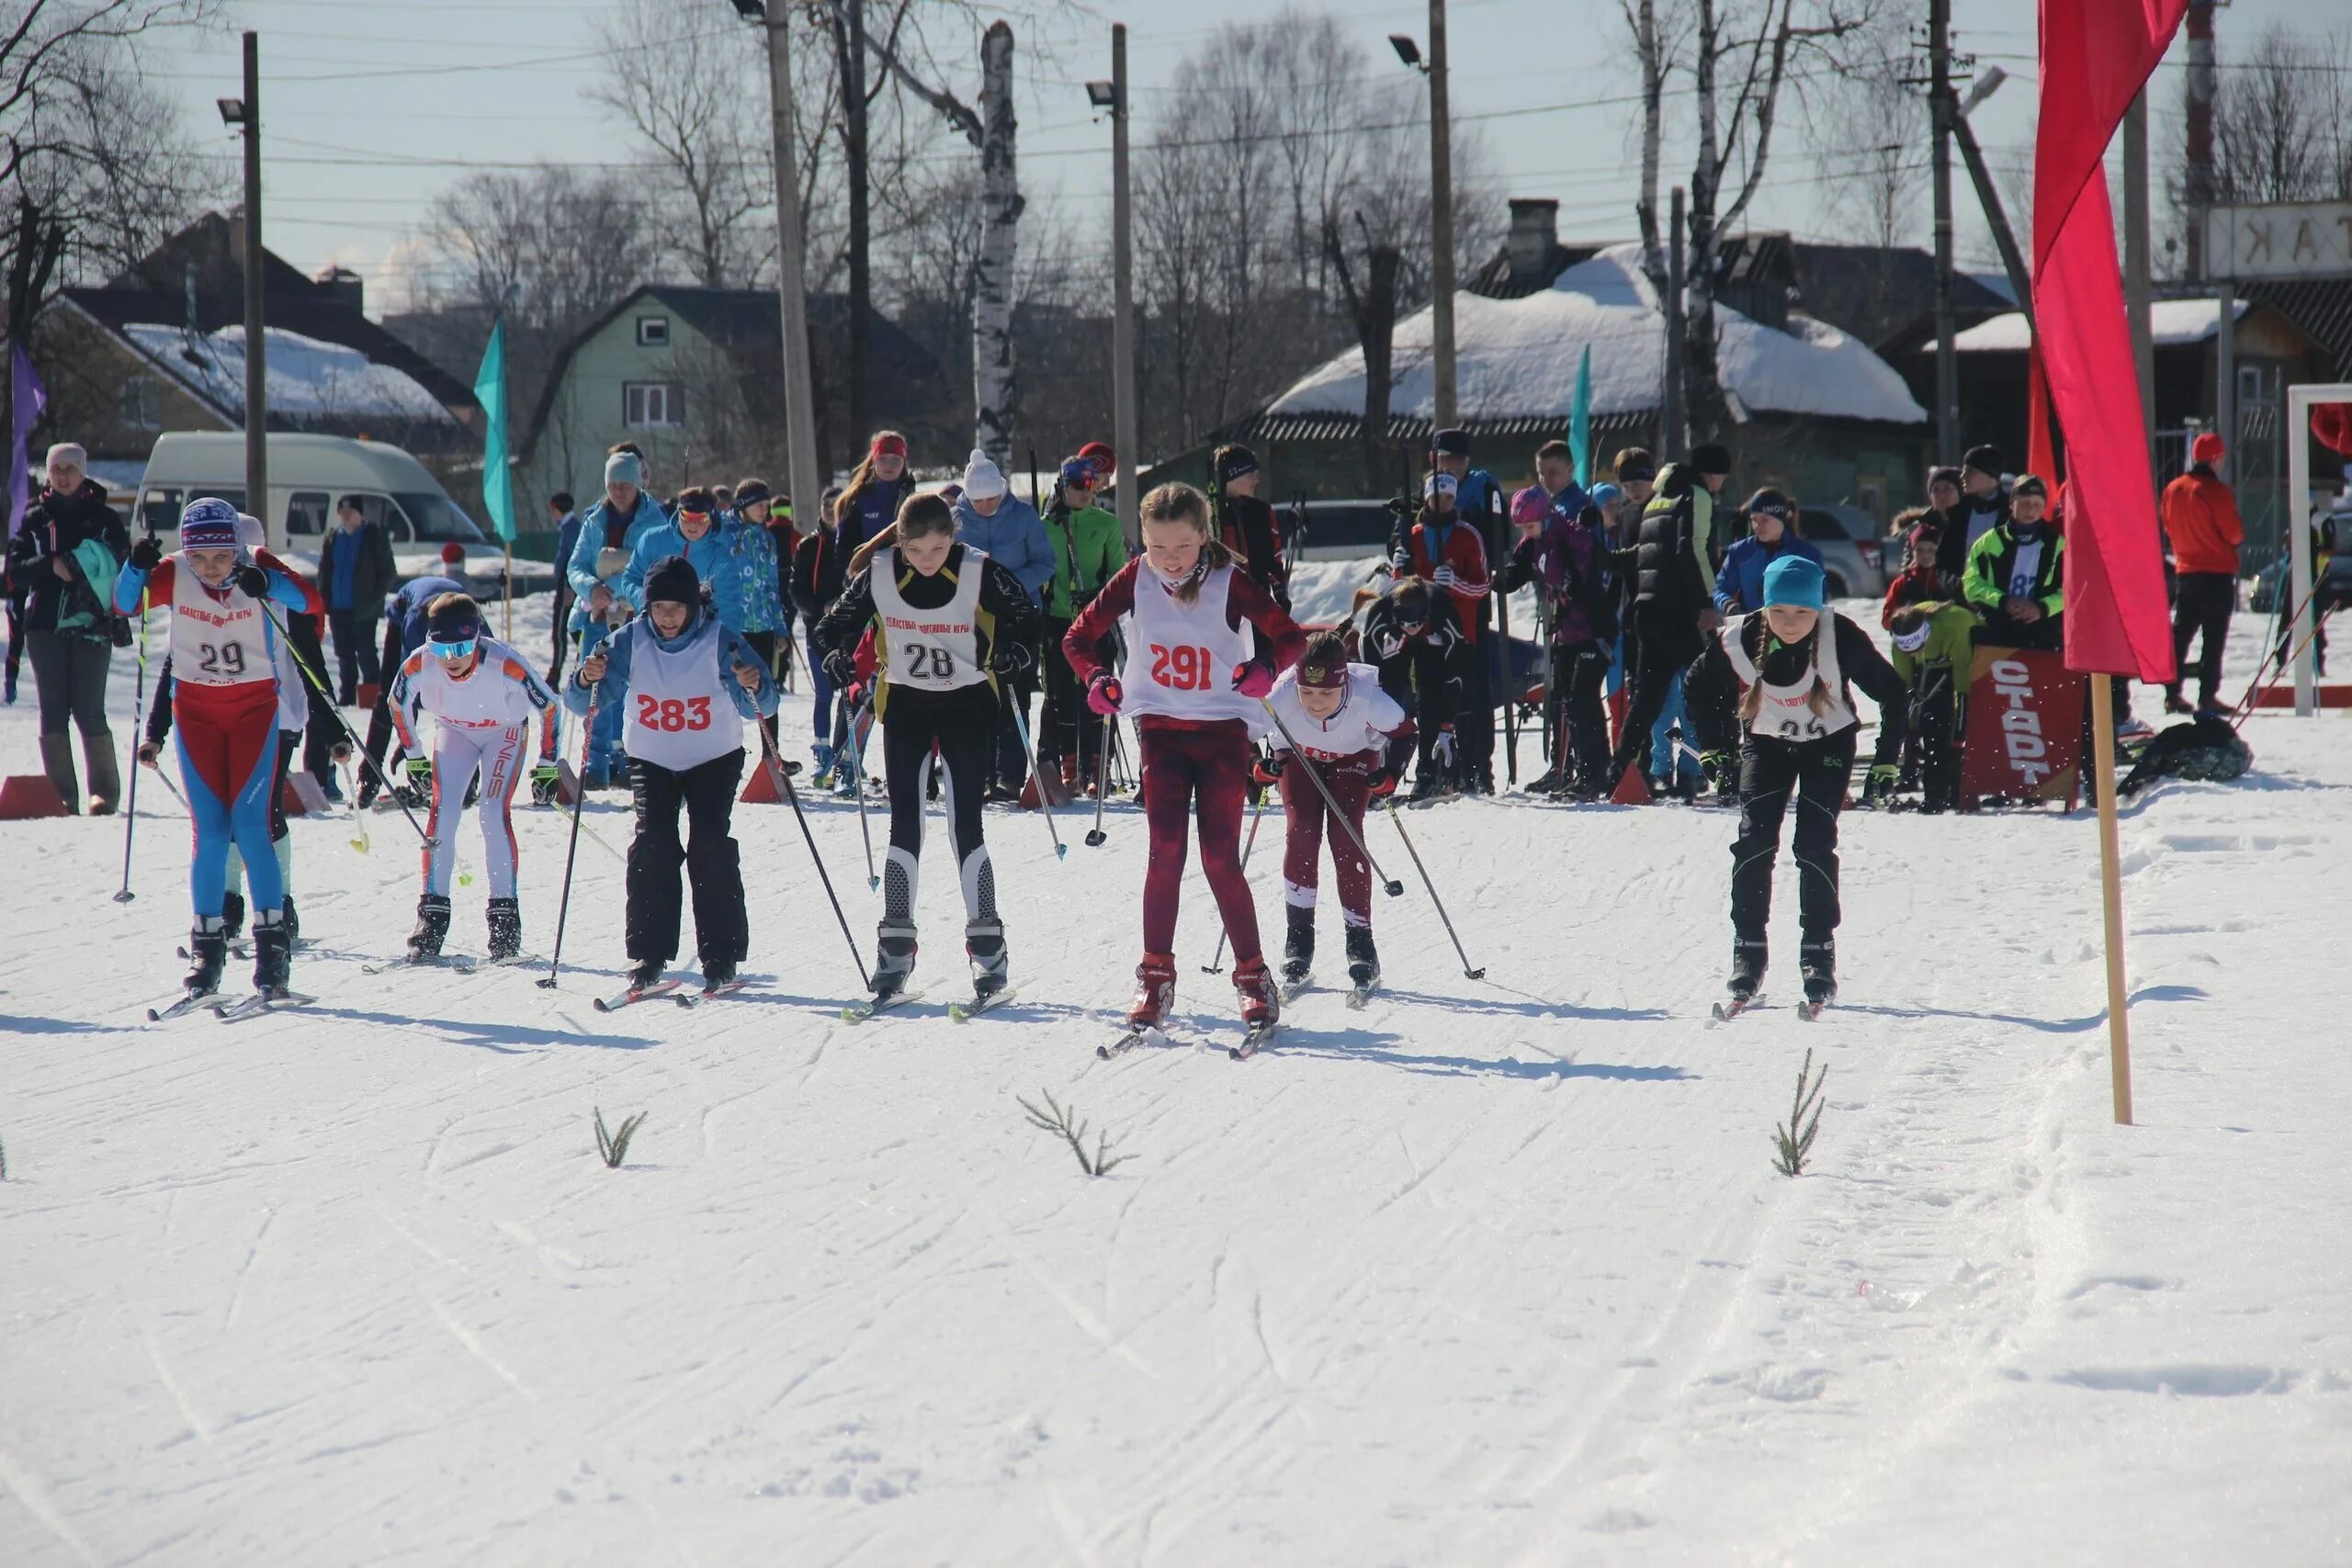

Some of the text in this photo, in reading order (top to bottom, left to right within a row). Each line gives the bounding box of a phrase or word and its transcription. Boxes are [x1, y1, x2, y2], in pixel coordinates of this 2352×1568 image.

[236, 607, 252, 620] ИГРЫ
[954, 624, 969, 634] ИГРЫ
[198, 639, 246, 676] 29
[904, 642, 956, 680] 28
[1149, 643, 1213, 692] 291
[637, 694, 711, 733] 283
[486, 728, 519, 800] SPINE
